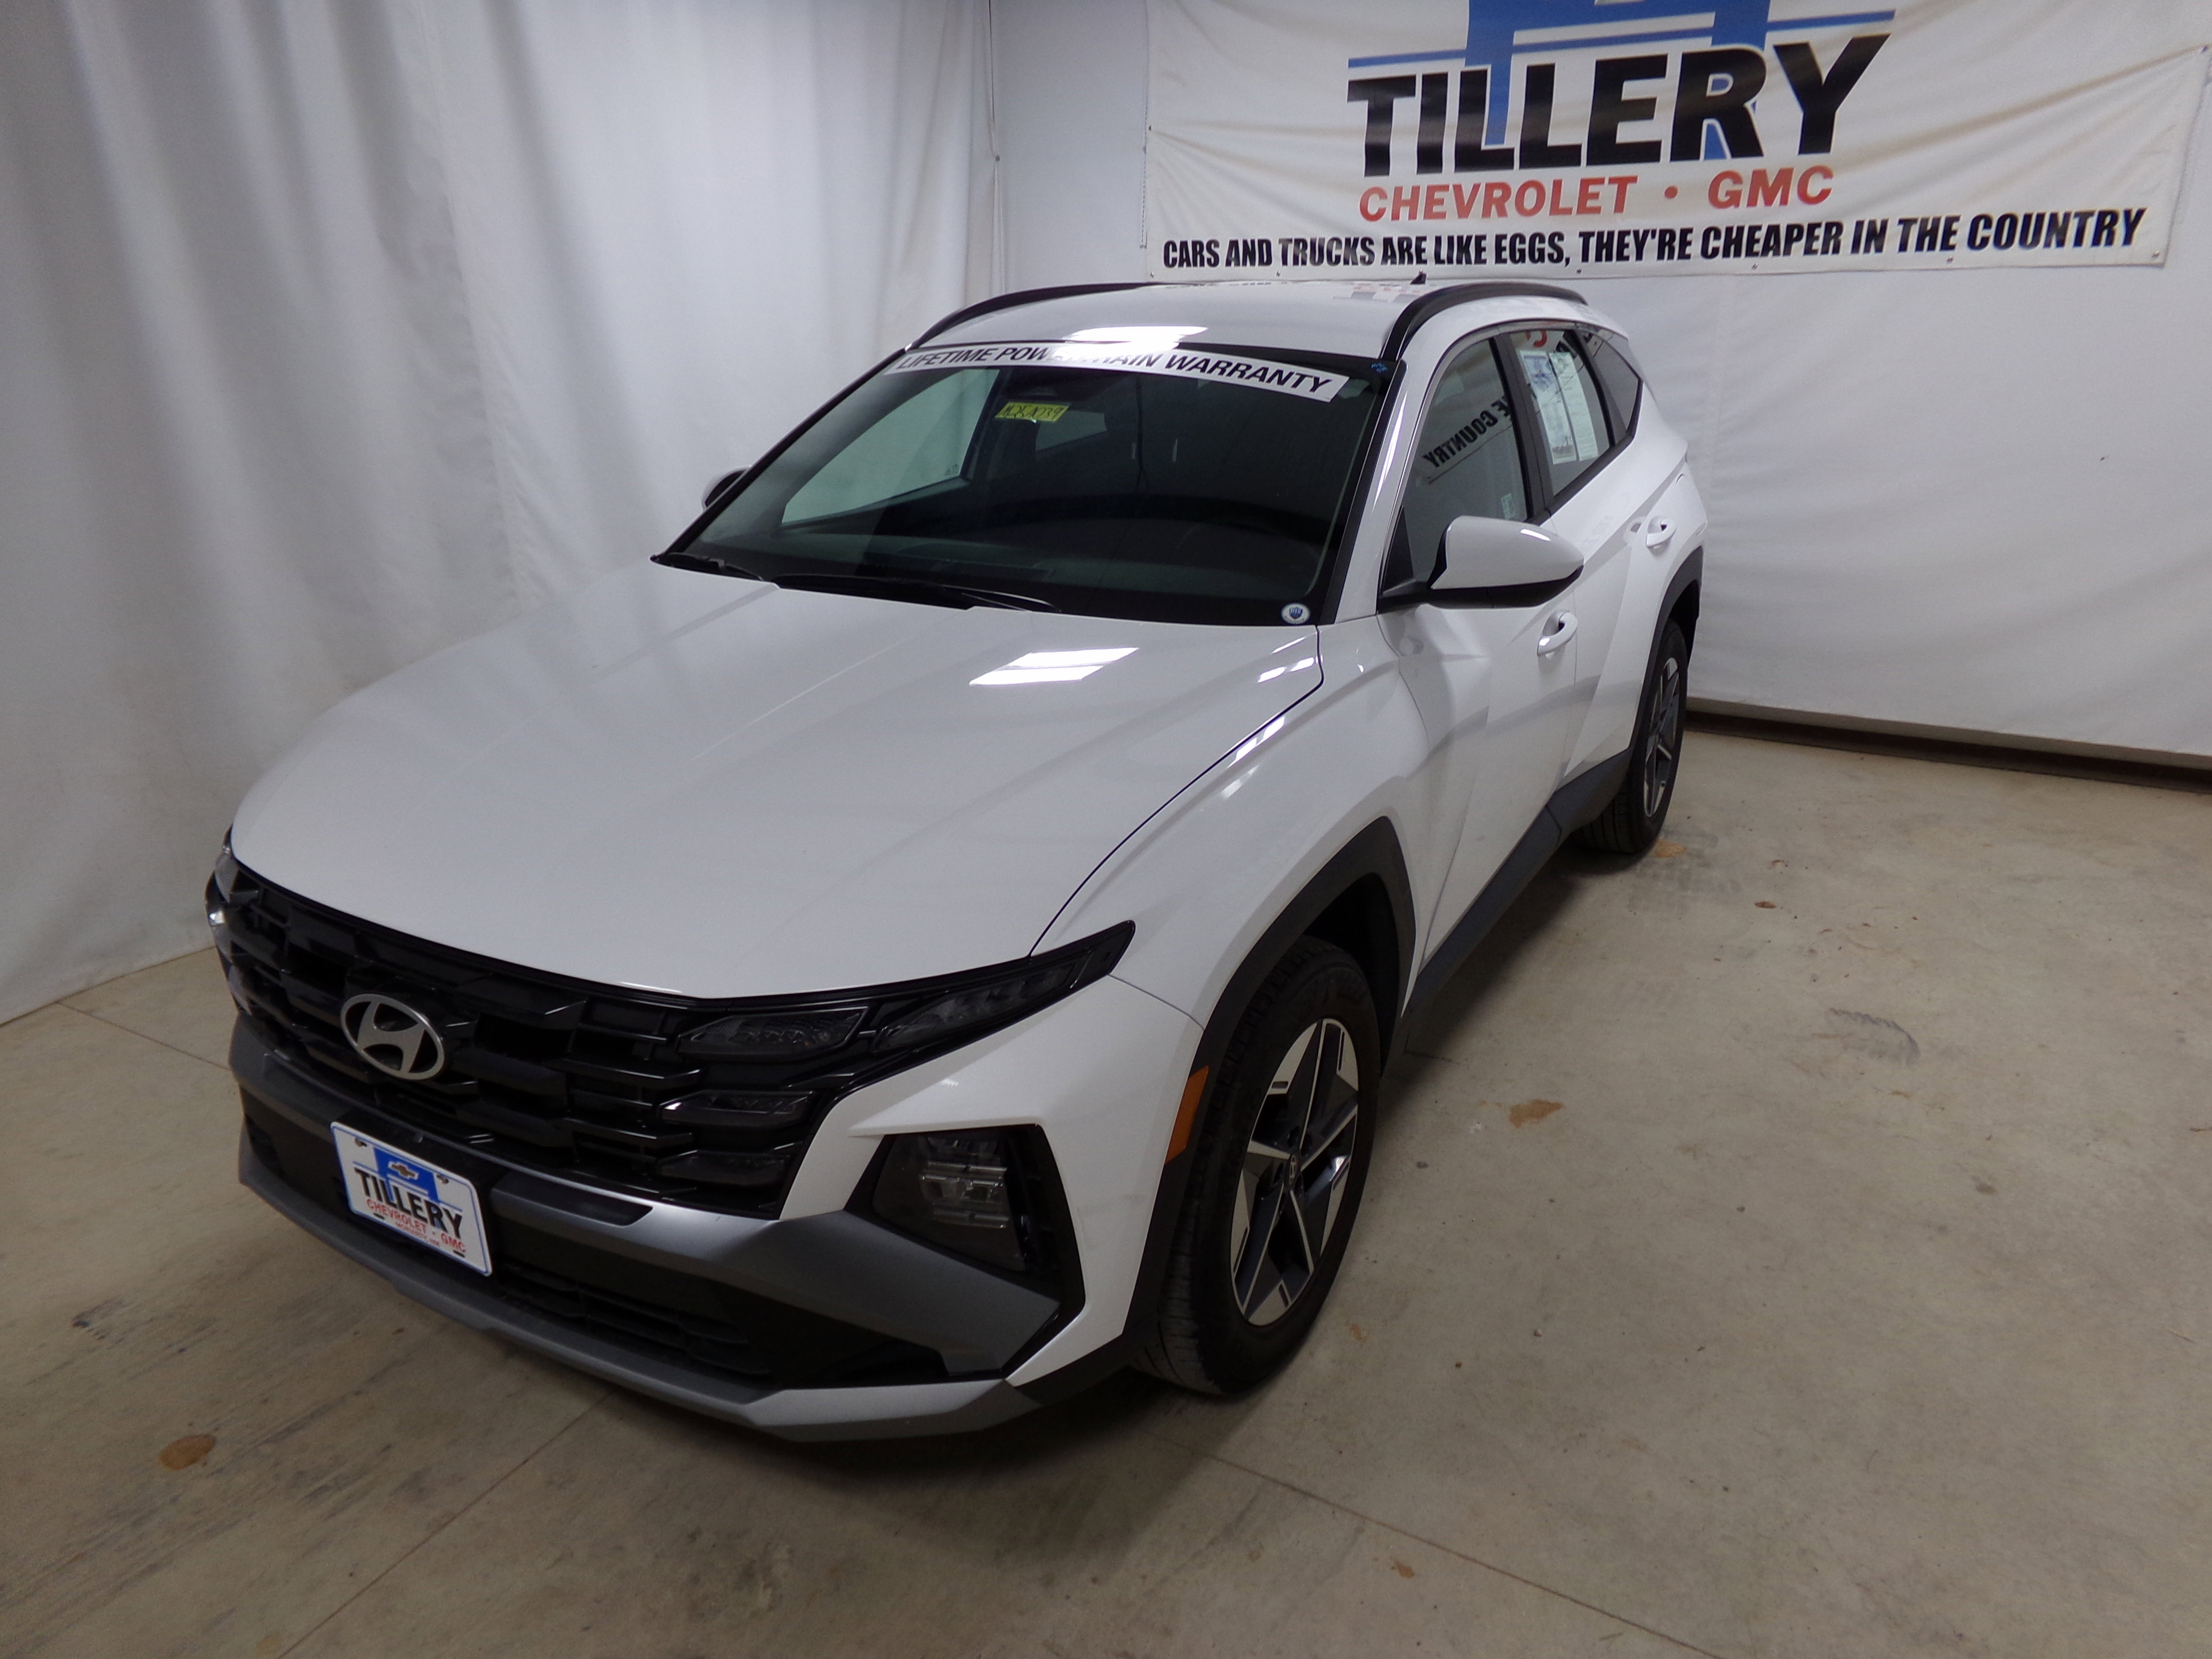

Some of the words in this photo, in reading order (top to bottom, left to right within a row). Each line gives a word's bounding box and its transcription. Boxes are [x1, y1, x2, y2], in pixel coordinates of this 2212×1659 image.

[1348, 34, 1891, 177] TILLERY
[1359, 176, 1638, 222] CHEVROLET
[1708, 164, 1834, 209] GMC
[1163, 239, 1220, 267] CARS
[1225, 238, 1272, 266] AND
[1278, 237, 1376, 266] TRUCKS
[1381, 236, 1427, 265] ARE
[1434, 234, 1487, 264] LIKE
[1494, 232, 1571, 267] EGGS,
[1579, 228, 1694, 263] THEY'RE
[1700, 221, 1843, 260] CHEAPER
[1850, 218, 1889, 254] IN
[1898, 215, 1961, 252] THE
[1968, 208, 2148, 250] COUNTRY
[897, 348, 995, 369] LIFETIME
[1165, 354, 1333, 393] WARRANTY
[354, 1167, 462, 1239] TILLERY
[367, 1199, 427, 1233] CHEVROLET
[441, 1233, 467, 1252] GMC
